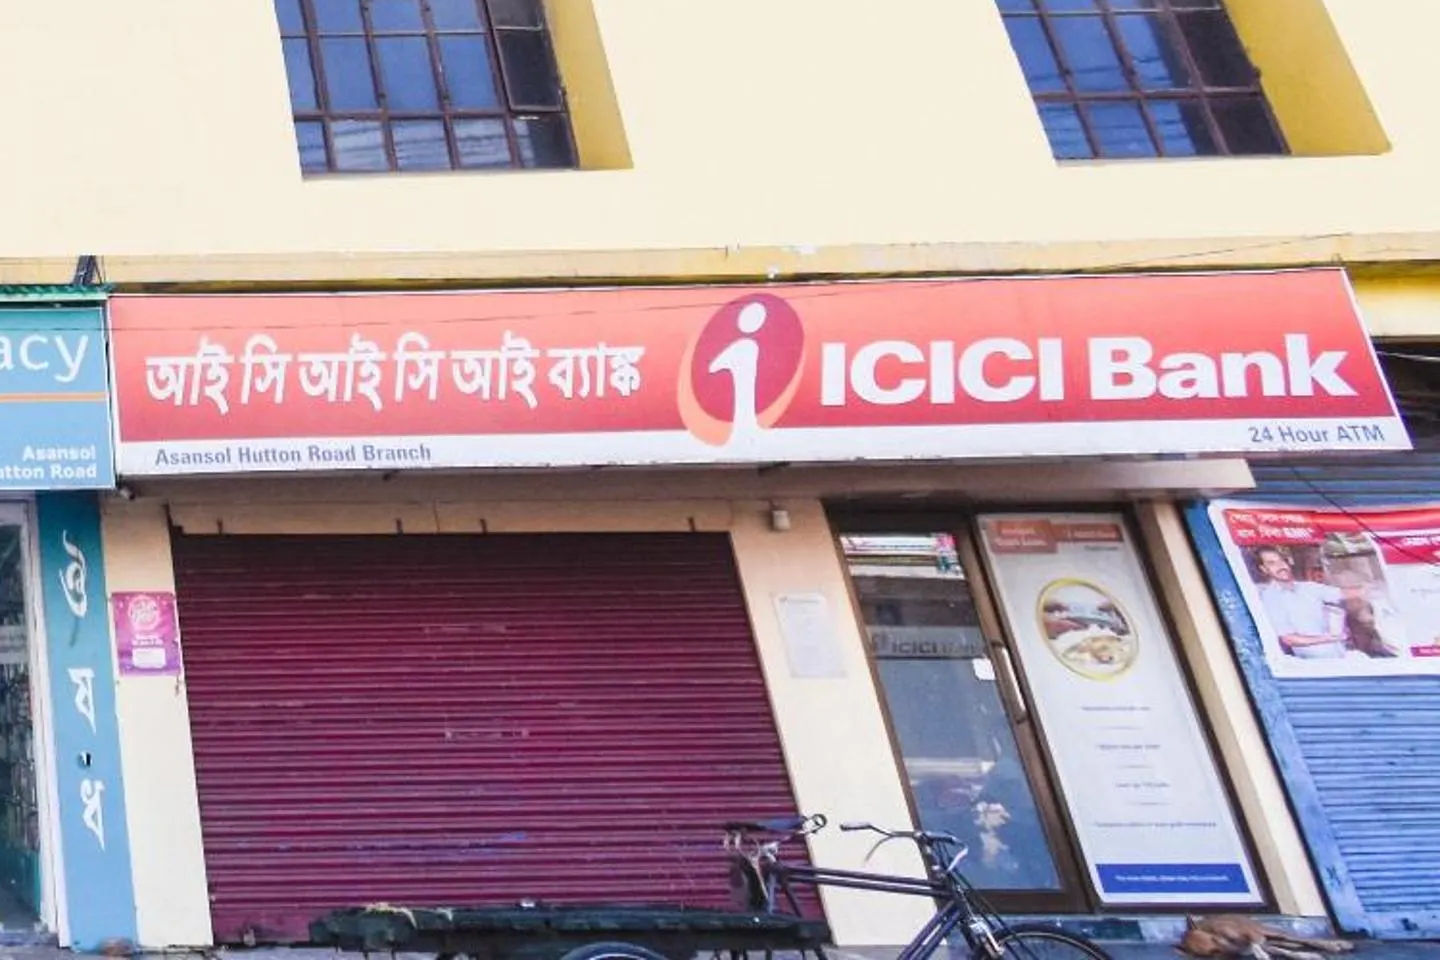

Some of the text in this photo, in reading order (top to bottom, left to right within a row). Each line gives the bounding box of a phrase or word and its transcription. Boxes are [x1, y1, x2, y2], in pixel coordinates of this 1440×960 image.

[145, 337, 236, 414] আই
[241, 334, 293, 403] সি
[298, 333, 386, 411] আই
[394, 332, 446, 401] সি
[452, 331, 539, 409] আই
[820, 336, 1065, 407] ICICI
[1088, 334, 1359, 400] Bank
[1248, 424, 1385, 443] 24 Hour ATM
[22, 445, 96, 461] Asansol
[154, 443, 431, 466] Asansol Hutton Road Branch
[50, 464, 97, 480] Road
